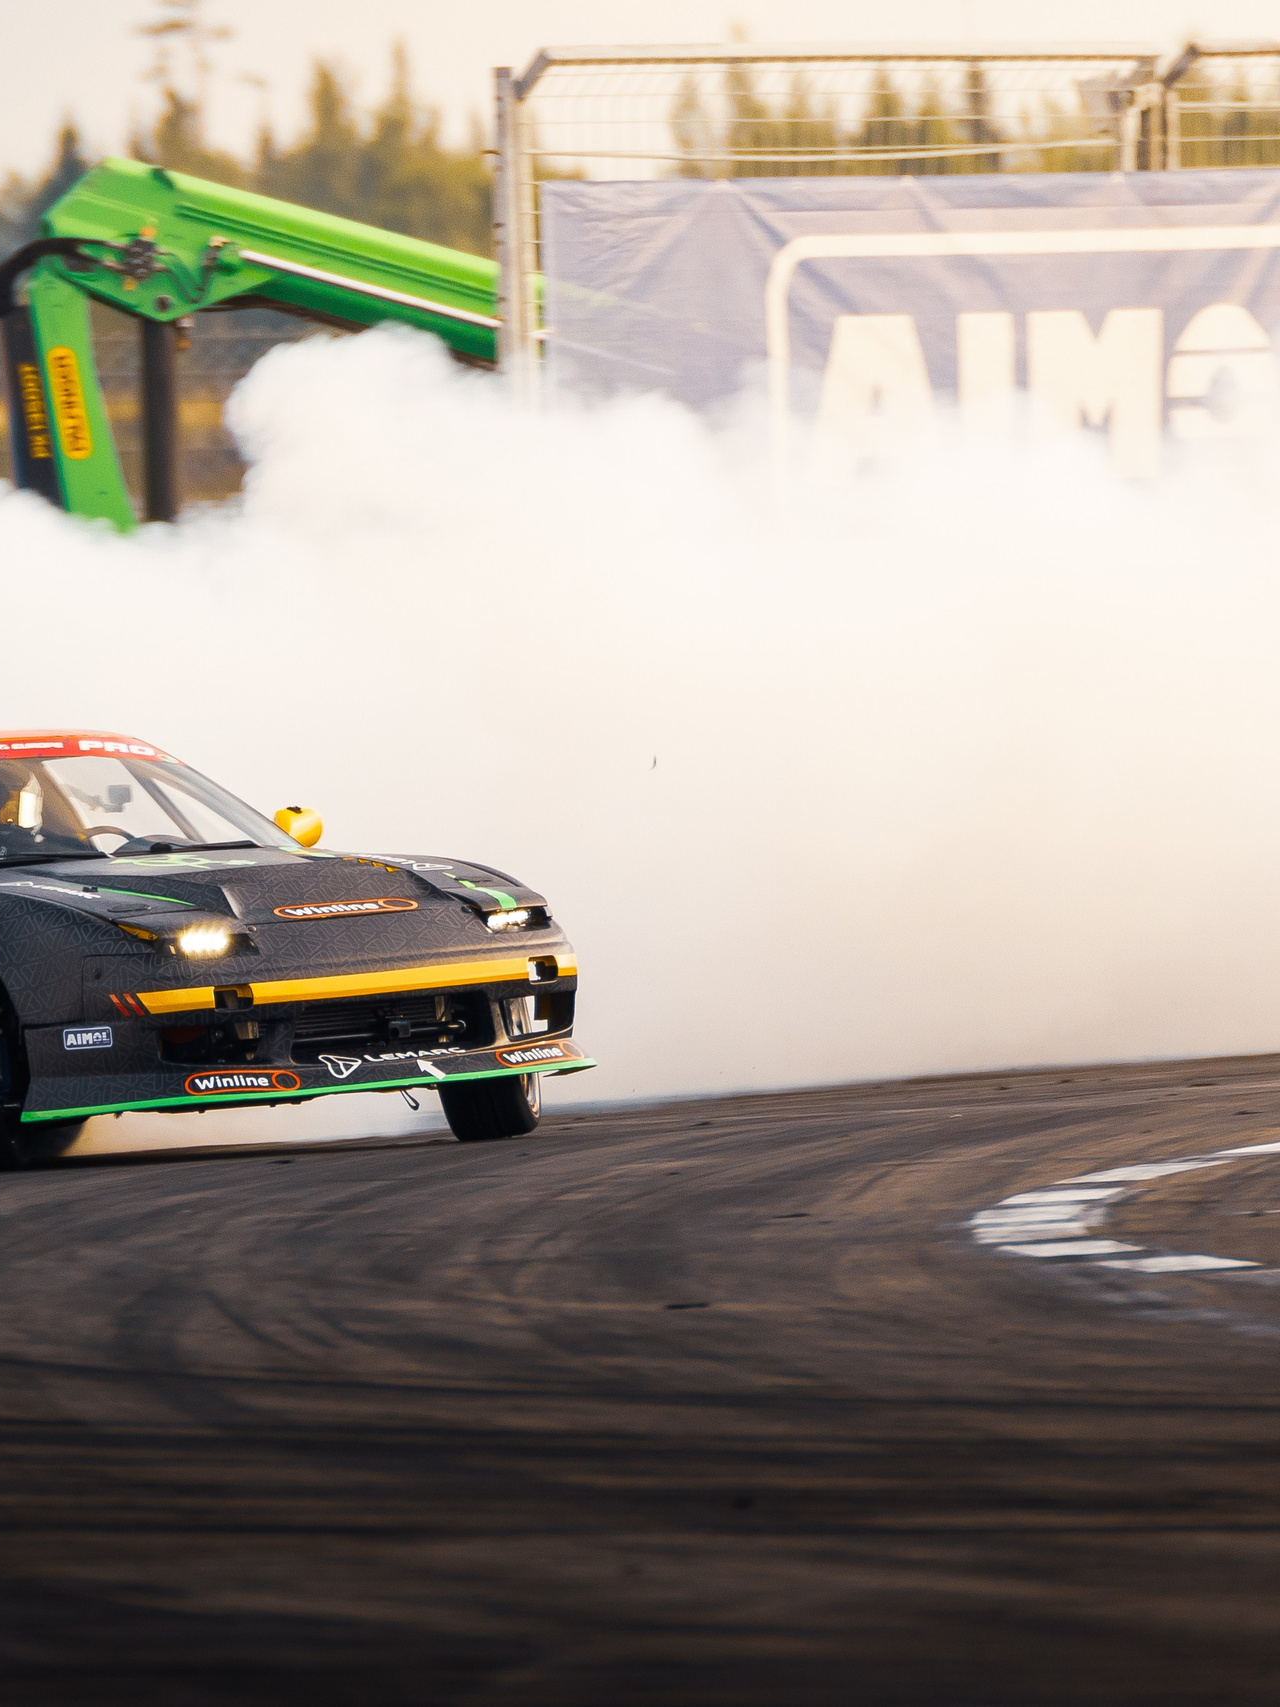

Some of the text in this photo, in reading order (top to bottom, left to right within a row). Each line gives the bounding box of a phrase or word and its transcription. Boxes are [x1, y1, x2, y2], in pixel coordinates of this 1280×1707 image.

[78, 740, 155, 756] PRO
[285, 899, 379, 918] Winline
[66, 1030, 110, 1046] AIMOL
[363, 1046, 467, 1063] LEMARC
[503, 1046, 564, 1065] Winline
[194, 1075, 270, 1090] Winline
